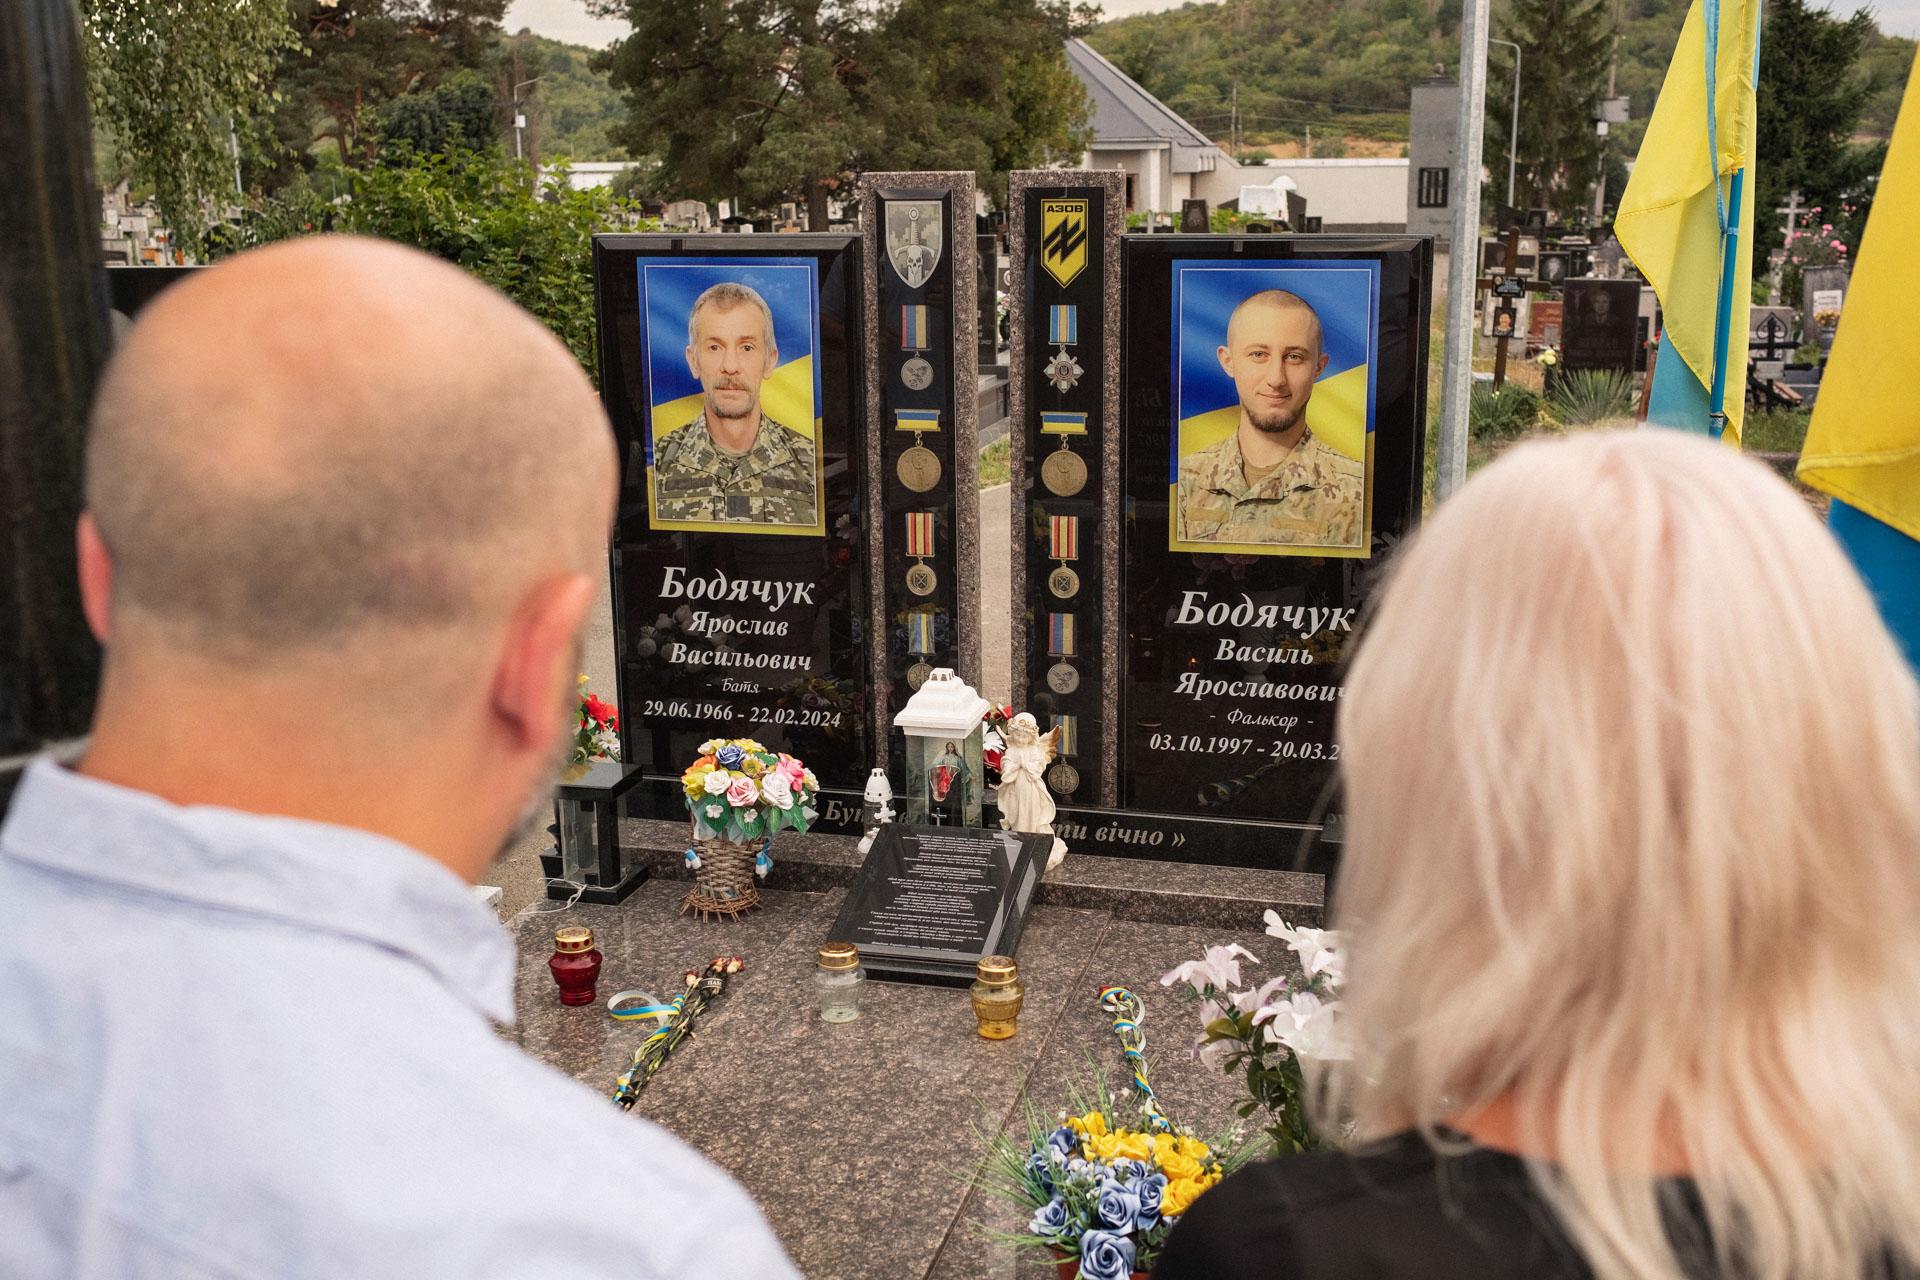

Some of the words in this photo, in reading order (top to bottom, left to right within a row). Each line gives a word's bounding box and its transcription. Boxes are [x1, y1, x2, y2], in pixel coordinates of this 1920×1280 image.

[658, 566, 815, 612] Бодячук
[688, 611, 789, 638] Ярослав
[1174, 590, 1355, 639] Бодячук
[669, 643, 812, 671] Васильович
[1214, 638, 1314, 665] Василь
[722, 677, 760, 694] Батя
[643, 700, 733, 721] 29.06.1966
[749, 707, 841, 728] 22.02.2024
[1227, 708, 1298, 734] Фалькор
[1150, 733, 1253, 756] 03.10.1997
[1270, 741, 1341, 760] 20.03.2
[1095, 821, 1163, 846] вічно
